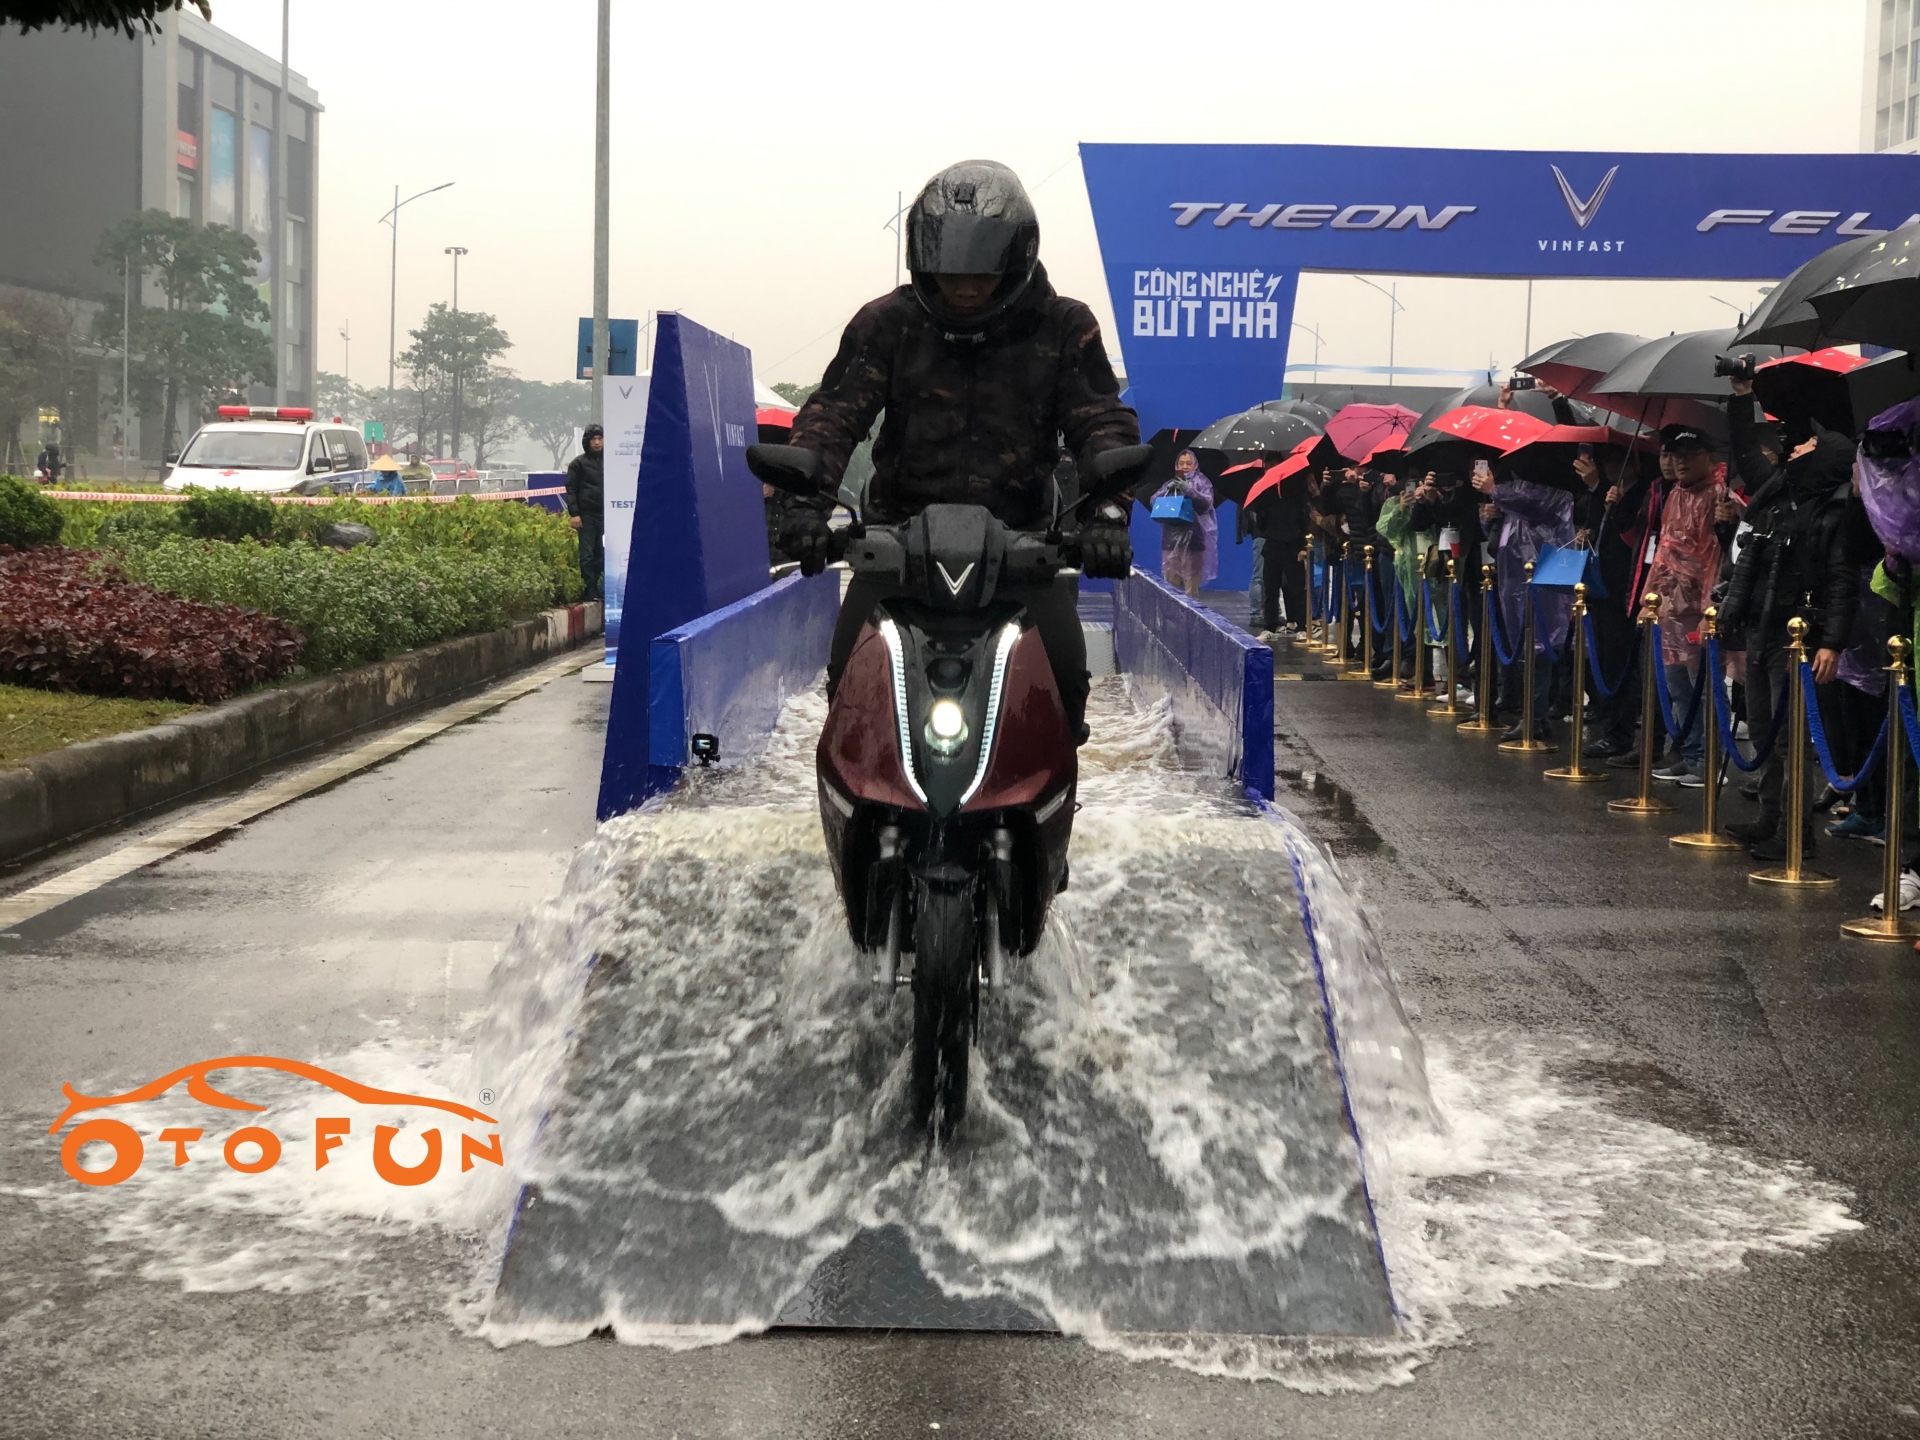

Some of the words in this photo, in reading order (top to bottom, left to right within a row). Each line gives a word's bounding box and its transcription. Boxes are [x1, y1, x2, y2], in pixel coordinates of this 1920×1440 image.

[1169, 202, 1477, 229] THEON
[1538, 240, 1625, 252] VINFAST
[1134, 267, 1197, 296] CÔNG
[1201, 268, 1264, 298] NGHỆ
[1133, 297, 1203, 337] BỨT
